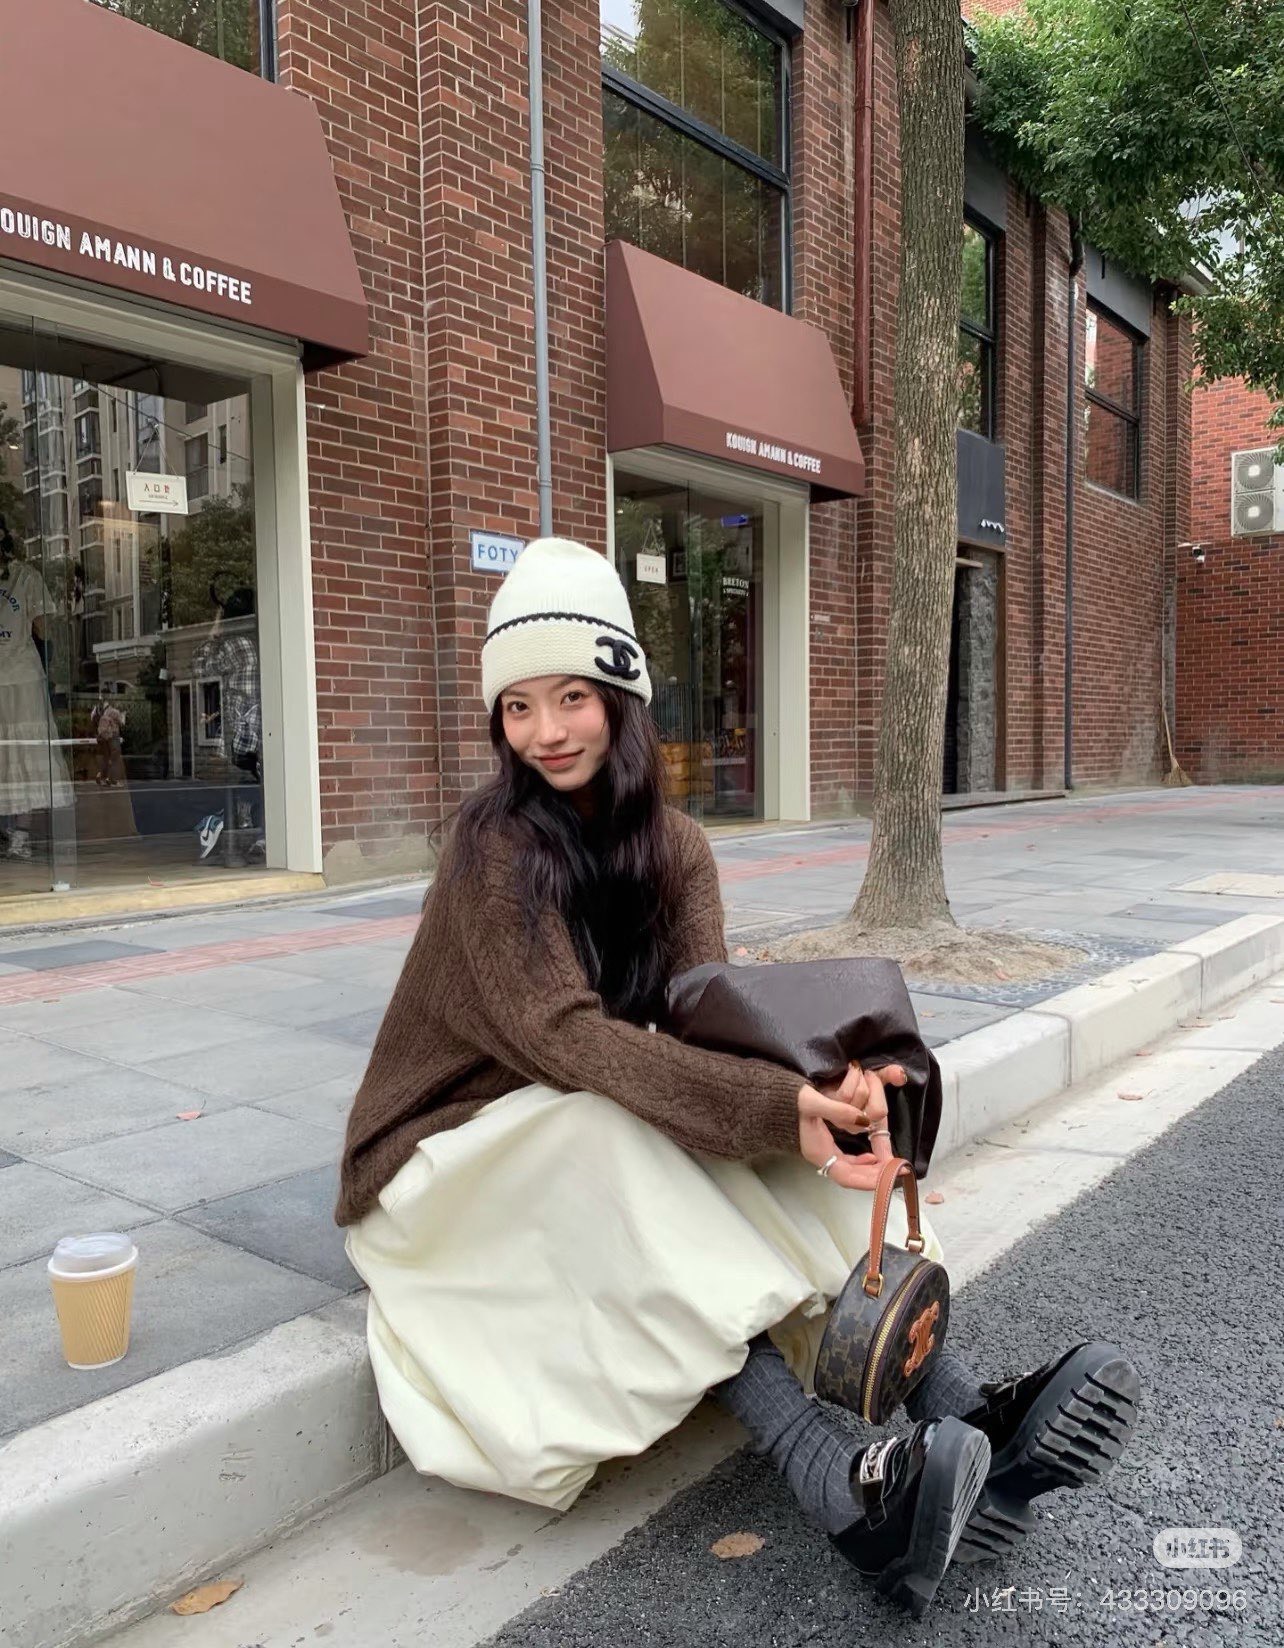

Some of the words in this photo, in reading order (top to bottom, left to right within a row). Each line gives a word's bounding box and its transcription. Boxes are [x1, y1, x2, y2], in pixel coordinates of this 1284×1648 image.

[0, 207, 71, 250] OUIGN
[79, 232, 156, 276] AMANN
[162, 257, 176, 282] &
[180, 262, 252, 304] COFFEE
[793, 452, 821, 474] COFFEE
[477, 543, 518, 562] FOTY
